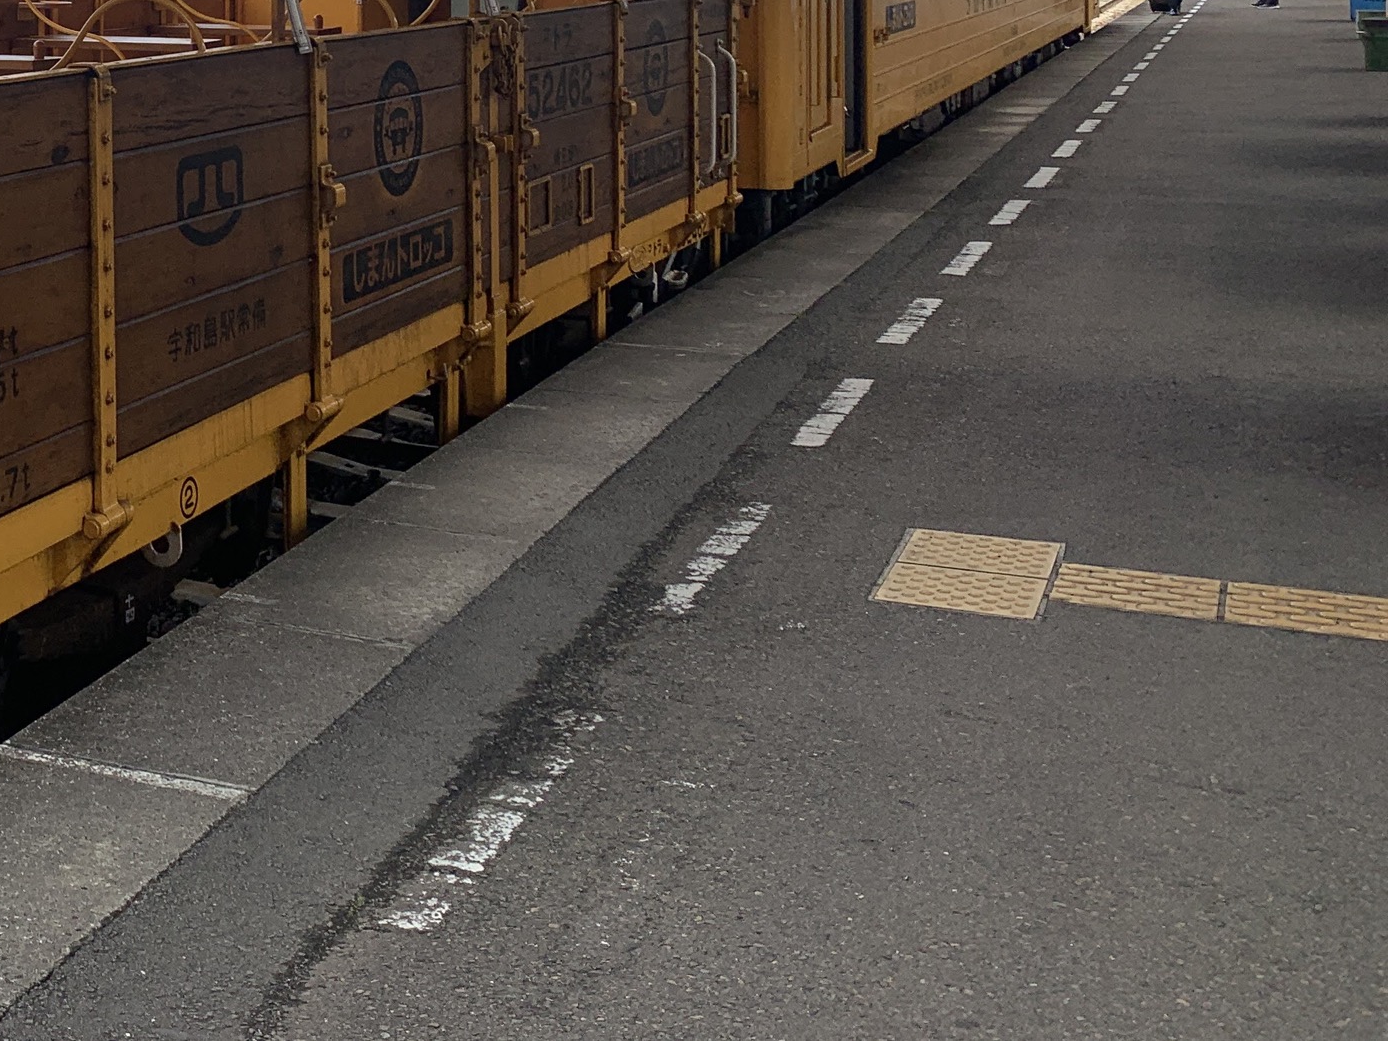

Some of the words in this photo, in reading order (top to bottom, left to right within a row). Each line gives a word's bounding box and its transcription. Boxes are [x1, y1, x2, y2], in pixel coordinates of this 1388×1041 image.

[353, 224, 445, 293] しまんトロッコ
